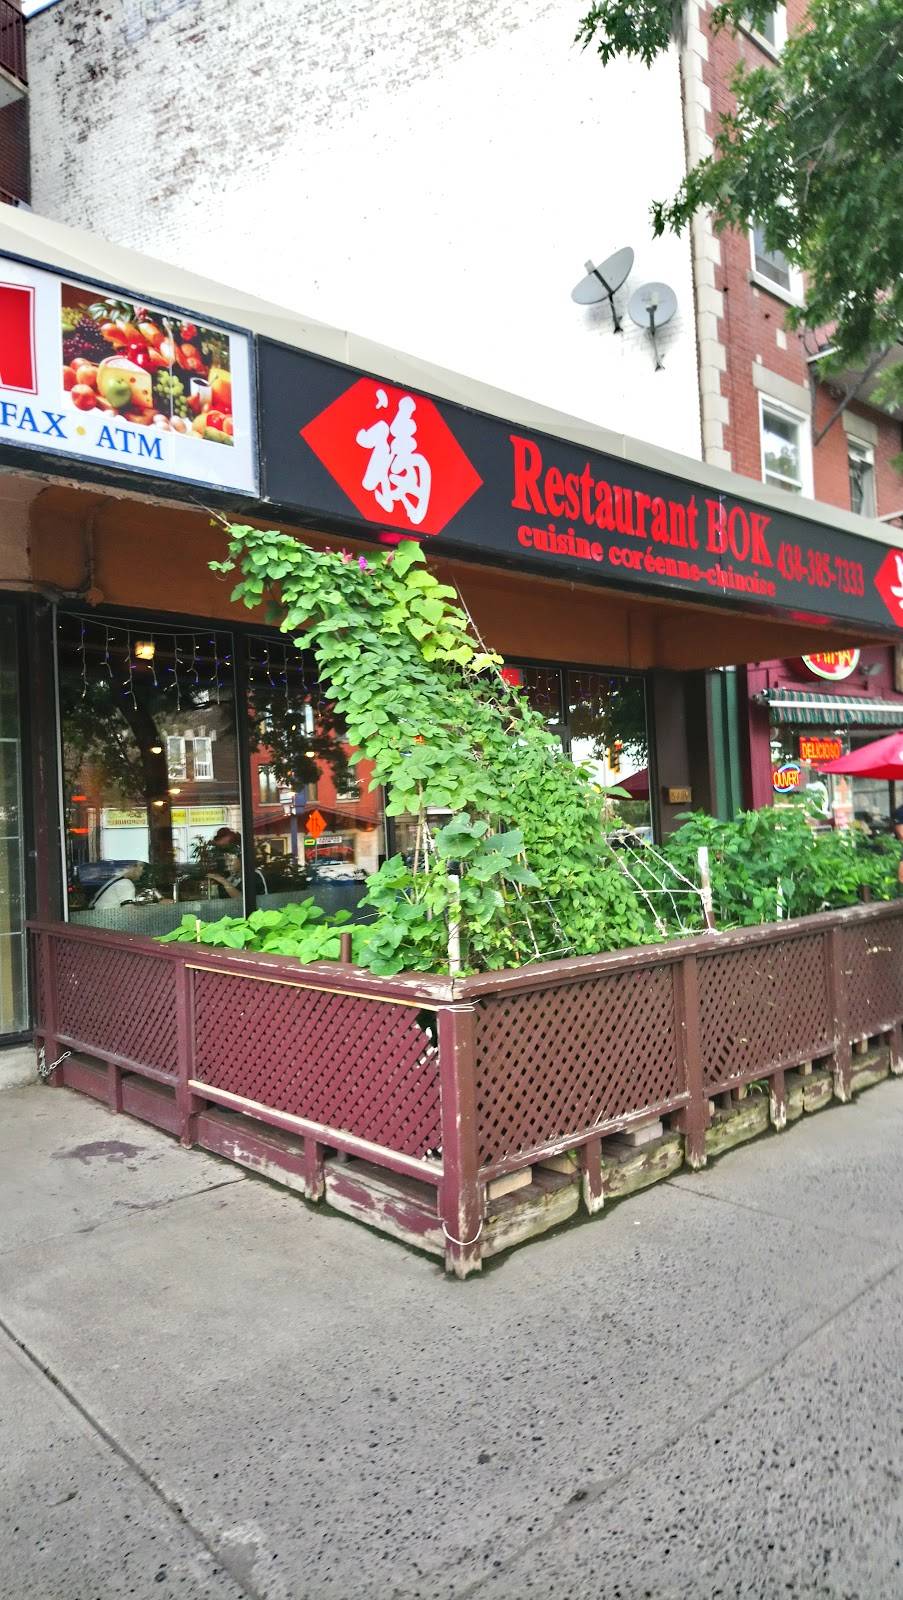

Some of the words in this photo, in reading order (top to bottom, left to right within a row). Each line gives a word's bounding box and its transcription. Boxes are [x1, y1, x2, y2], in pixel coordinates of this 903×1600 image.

[0, 402, 68, 439] FAX
[96, 425, 165, 460] ATM
[356, 389, 432, 525] 福
[509, 434, 699, 550] Restaurant
[705, 499, 774, 568] BOK
[517, 523, 604, 562] cuisine
[608, 546, 777, 597] coréenne-chinoise
[777, 543, 865, 597] 438-385-7333
[773, 770, 800, 787] OUVERT
[801, 741, 841, 759] DELICIOSO
